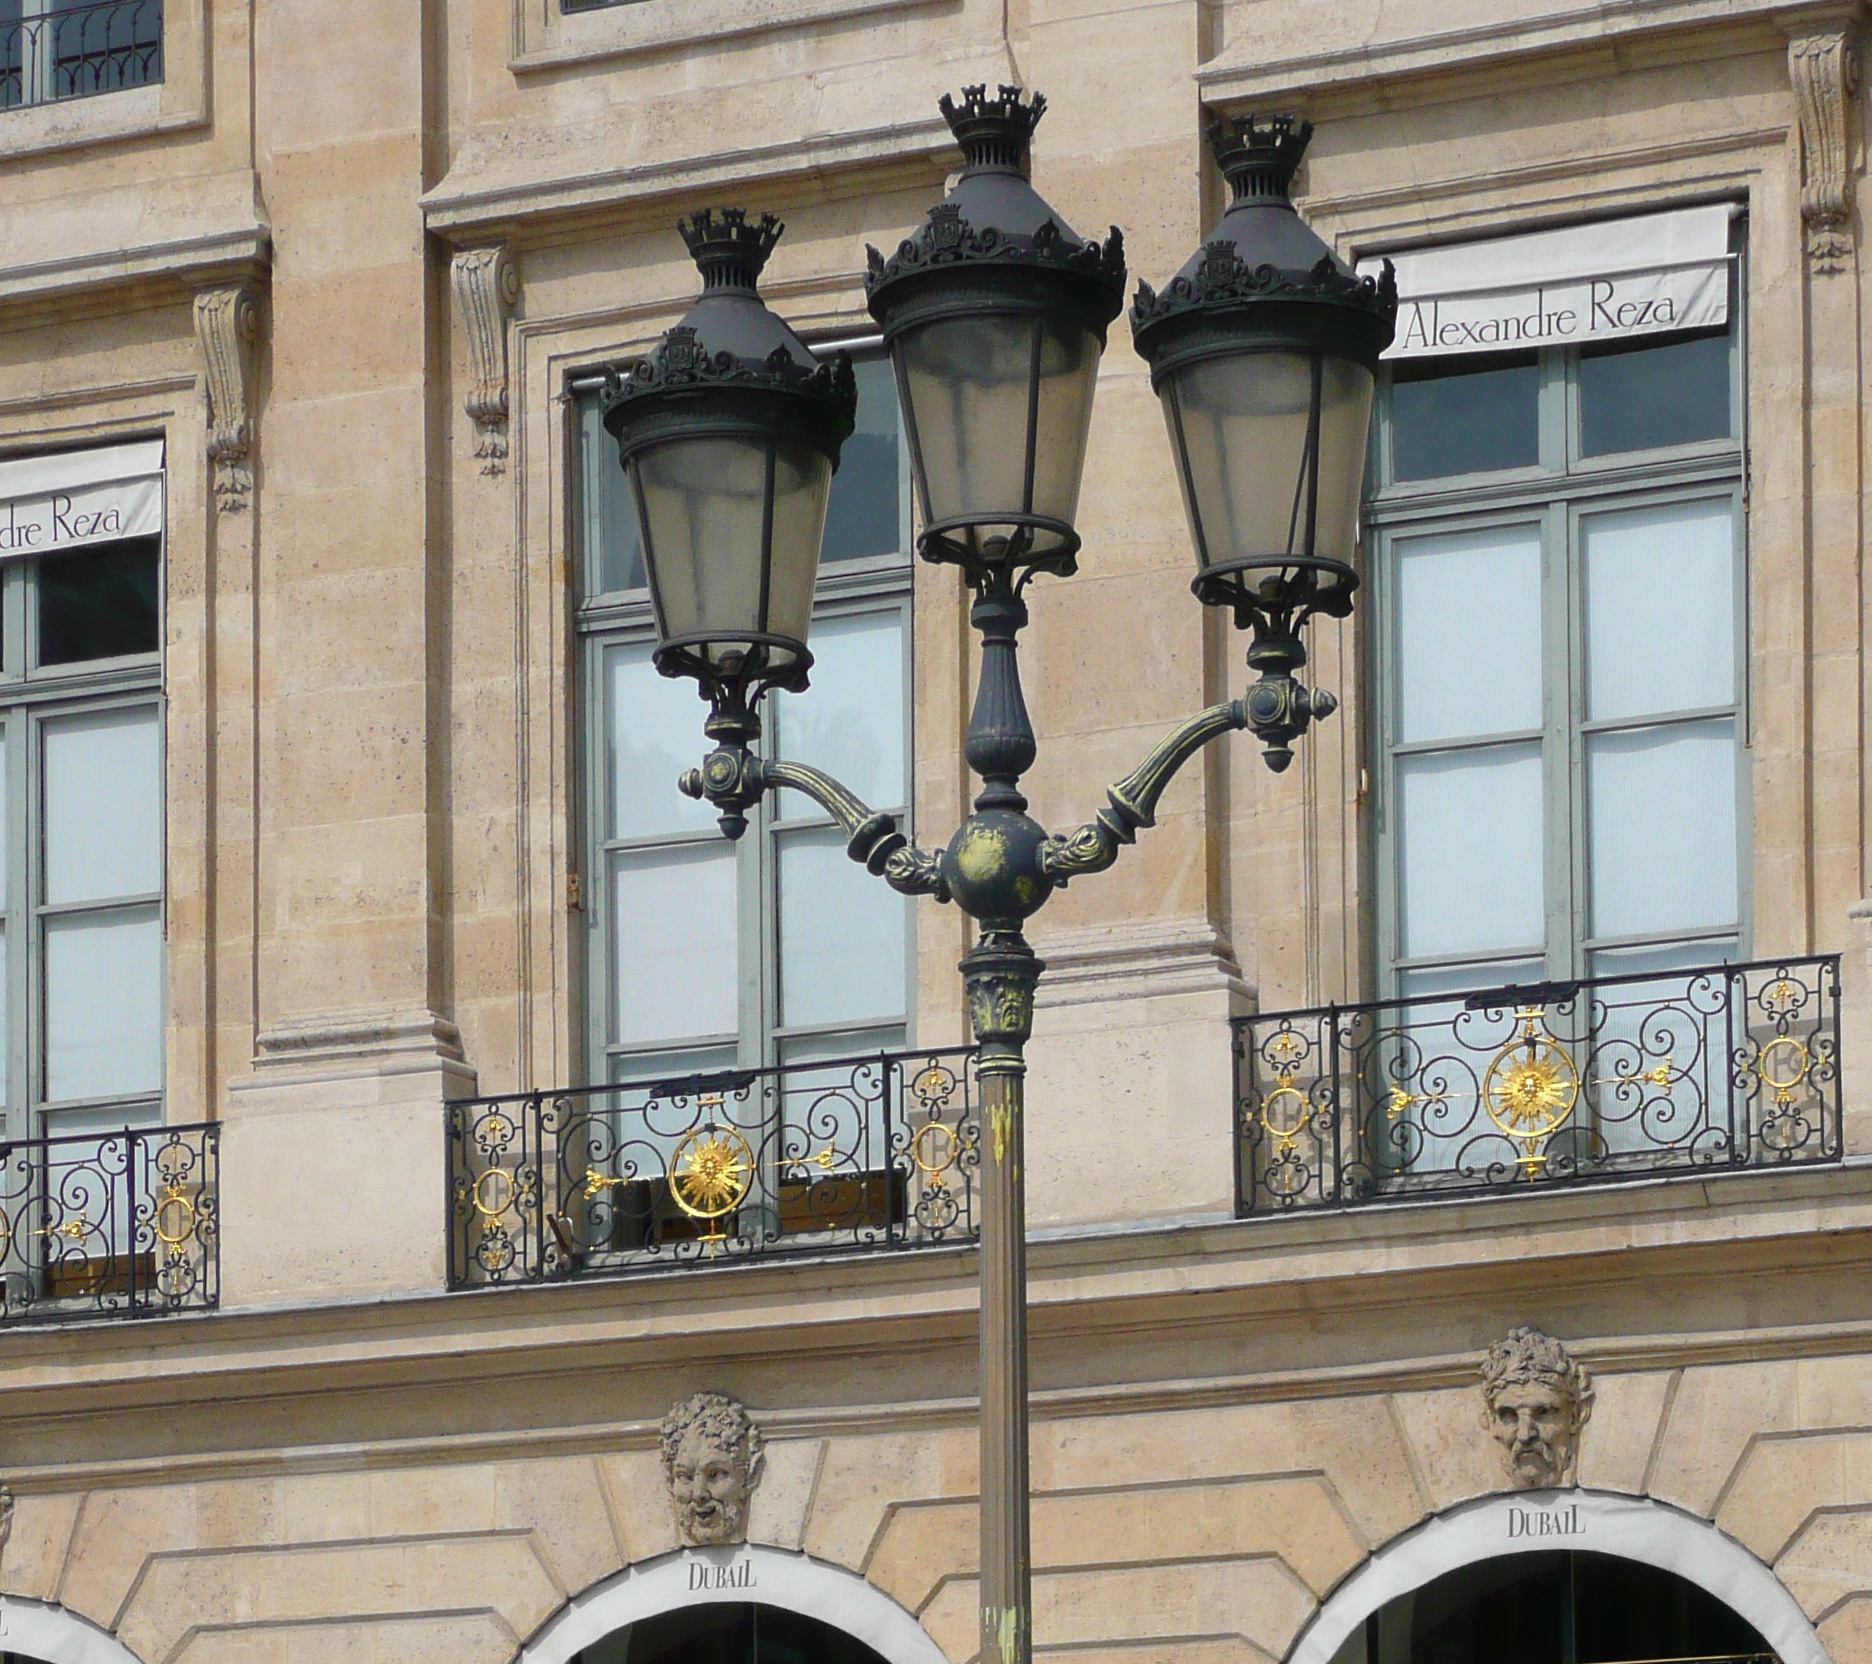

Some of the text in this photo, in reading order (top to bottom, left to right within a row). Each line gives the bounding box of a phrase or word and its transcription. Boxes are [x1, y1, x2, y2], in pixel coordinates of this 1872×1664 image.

[1403, 279, 1676, 349] Alexandre Reza
[52, 494, 120, 542] Reza
[1507, 1504, 1586, 1538] DUBAIL
[688, 1559, 757, 1591] DUBAIL
